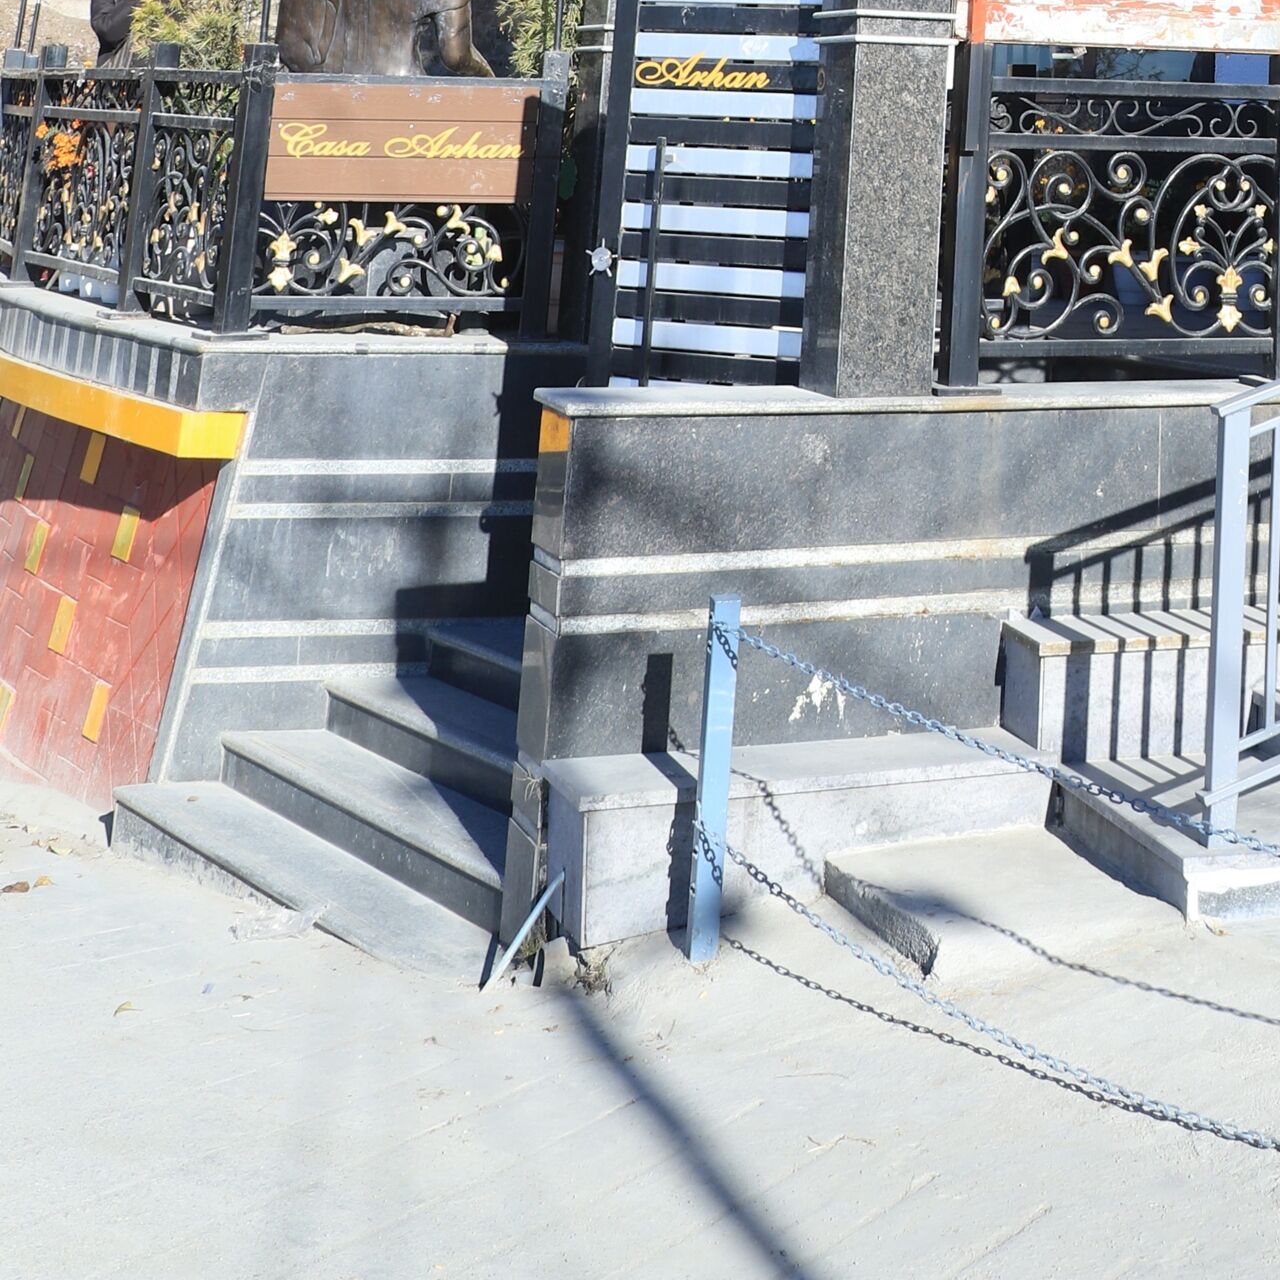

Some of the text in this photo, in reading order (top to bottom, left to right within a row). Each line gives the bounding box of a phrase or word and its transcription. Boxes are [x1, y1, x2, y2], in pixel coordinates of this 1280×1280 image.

[635, 50, 770, 89] Arhan
[279, 122, 525, 160] Casa Arhan
